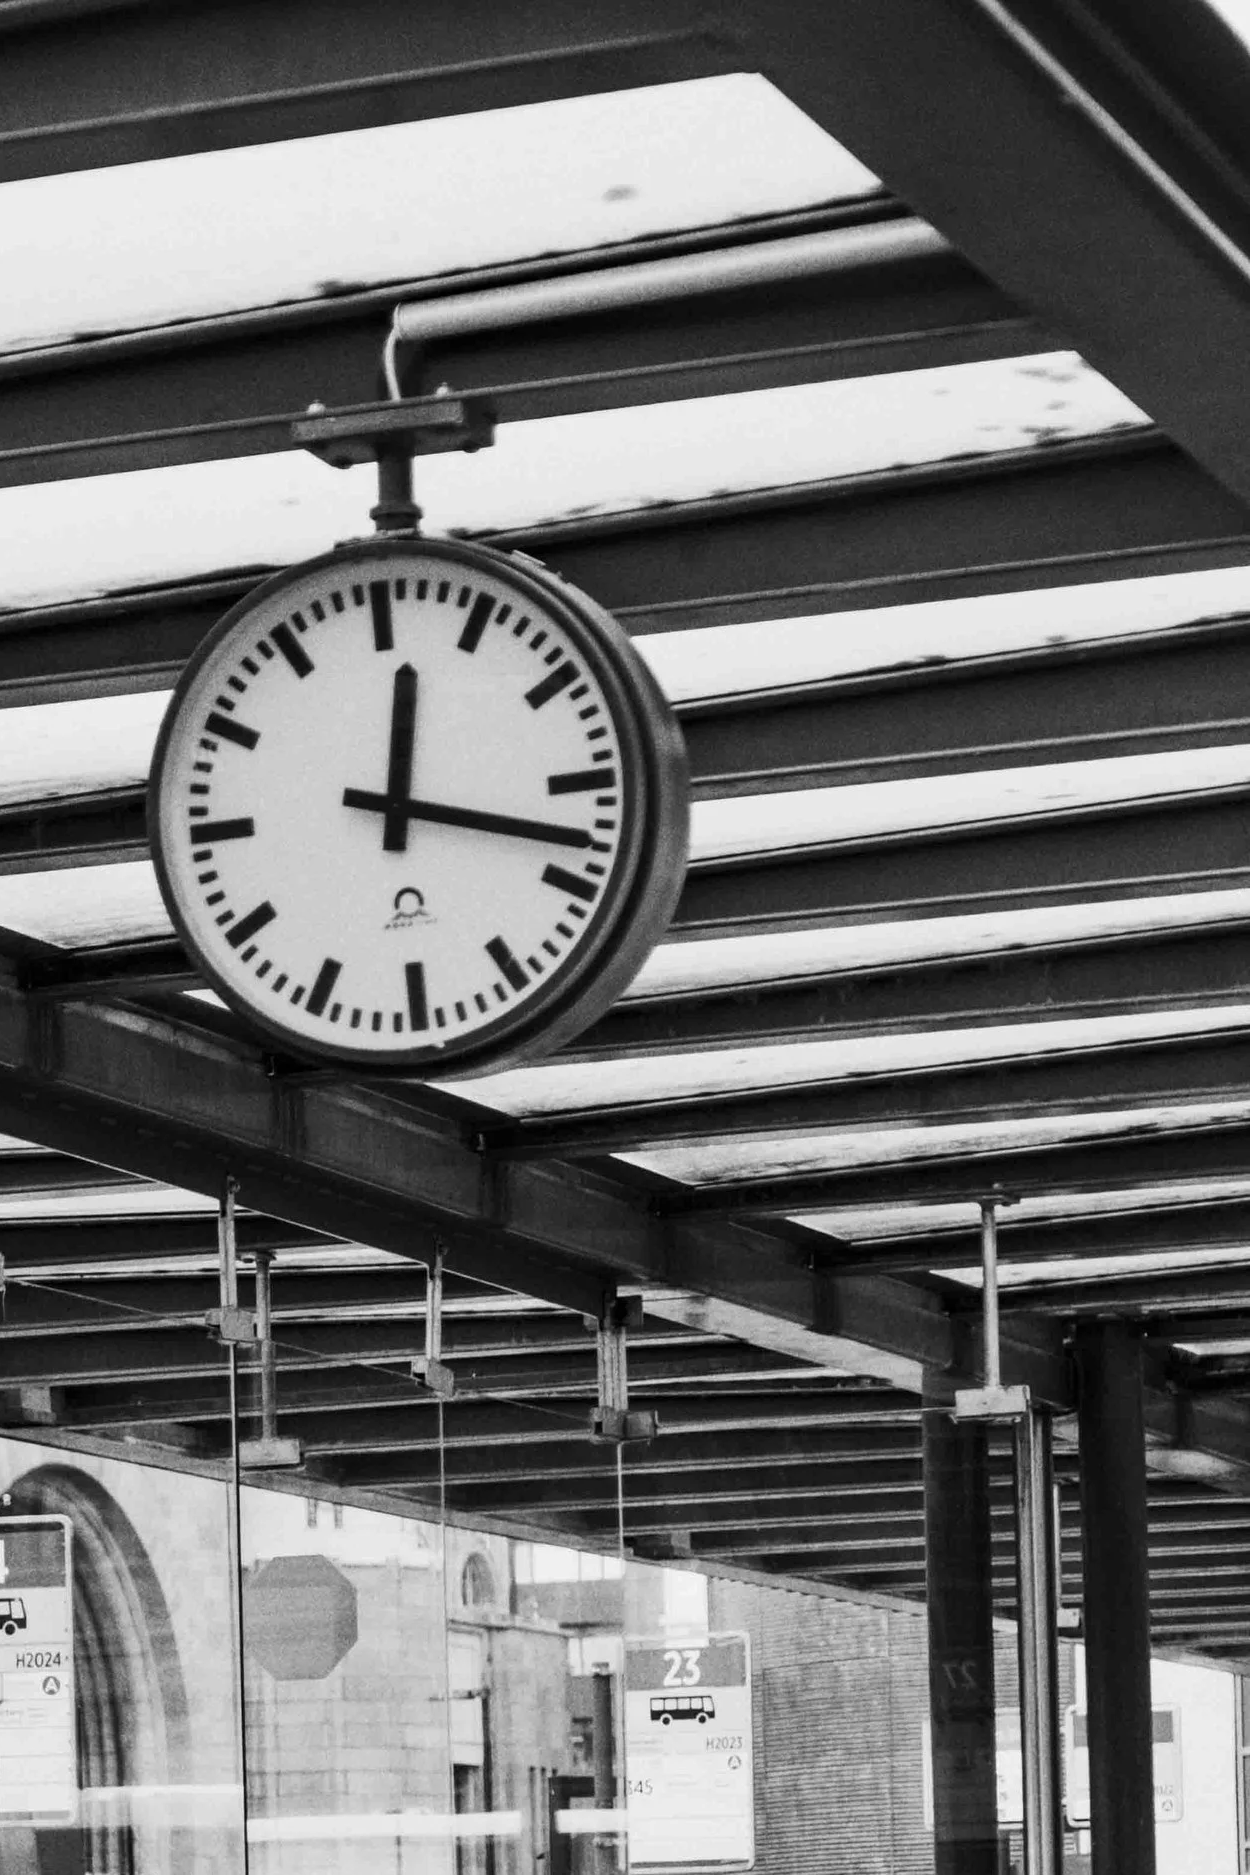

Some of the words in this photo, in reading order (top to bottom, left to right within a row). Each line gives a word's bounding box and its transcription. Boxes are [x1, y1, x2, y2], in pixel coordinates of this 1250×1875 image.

[16, 1652, 61, 1669] H2024
[662, 1650, 701, 1686] 23
[706, 1736, 743, 1751] H2023
